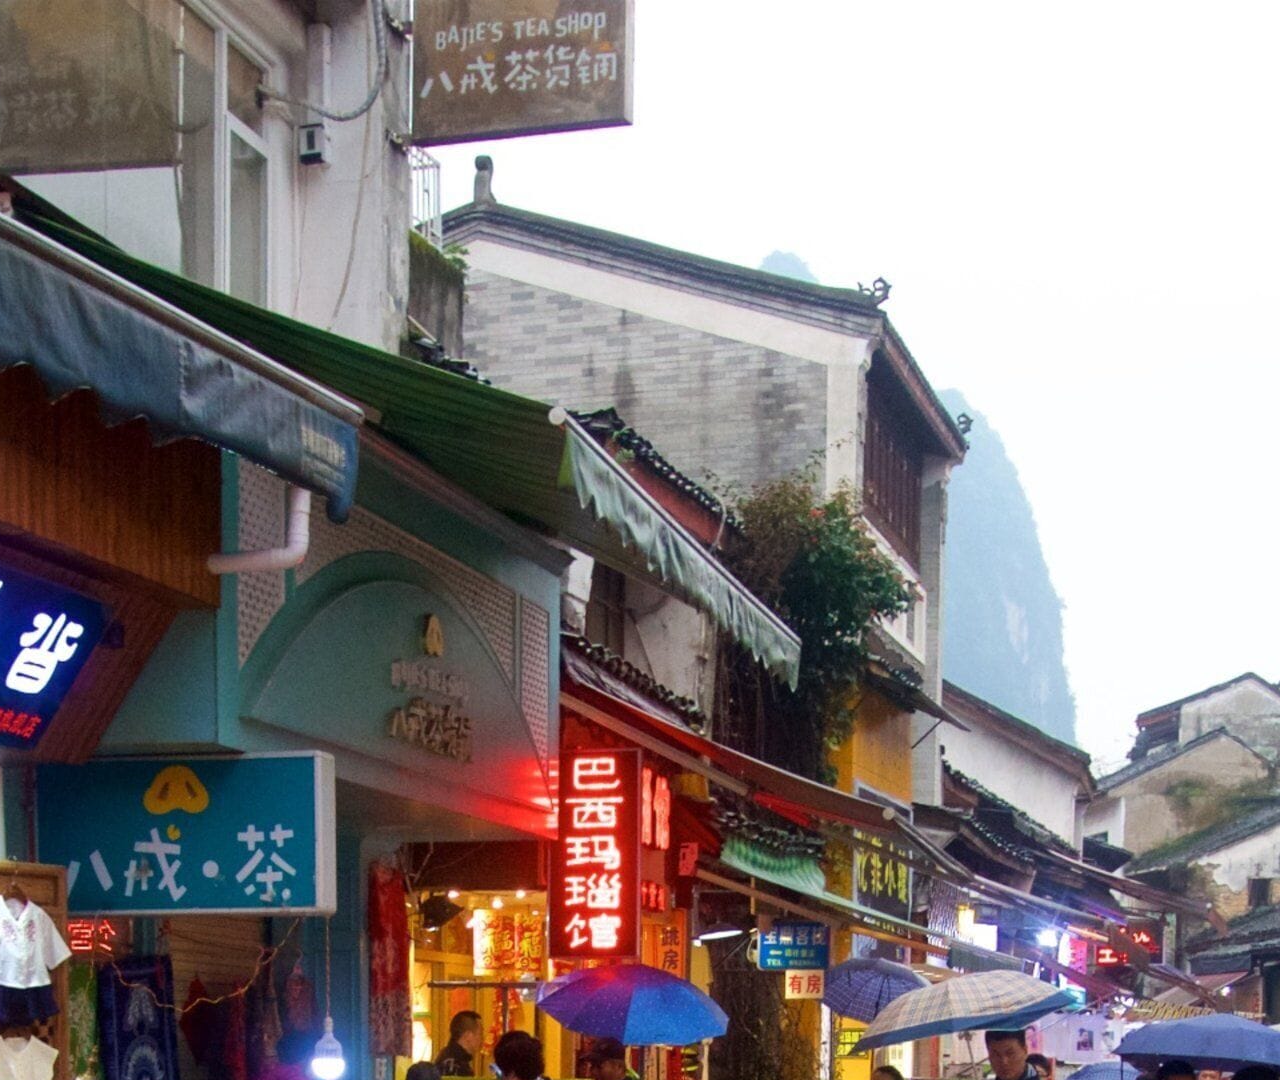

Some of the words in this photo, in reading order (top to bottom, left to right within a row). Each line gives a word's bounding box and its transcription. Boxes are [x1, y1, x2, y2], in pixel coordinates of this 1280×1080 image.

[435, 21, 504, 51] BAJIE'S
[513, 18, 550, 40] TEA
[555, 11, 606, 40] SHOP
[420, 44, 618, 99] 八戒茶货铺
[564, 756, 624, 949] 巴西玛瑙馆
[788, 974, 822, 994] 有房
